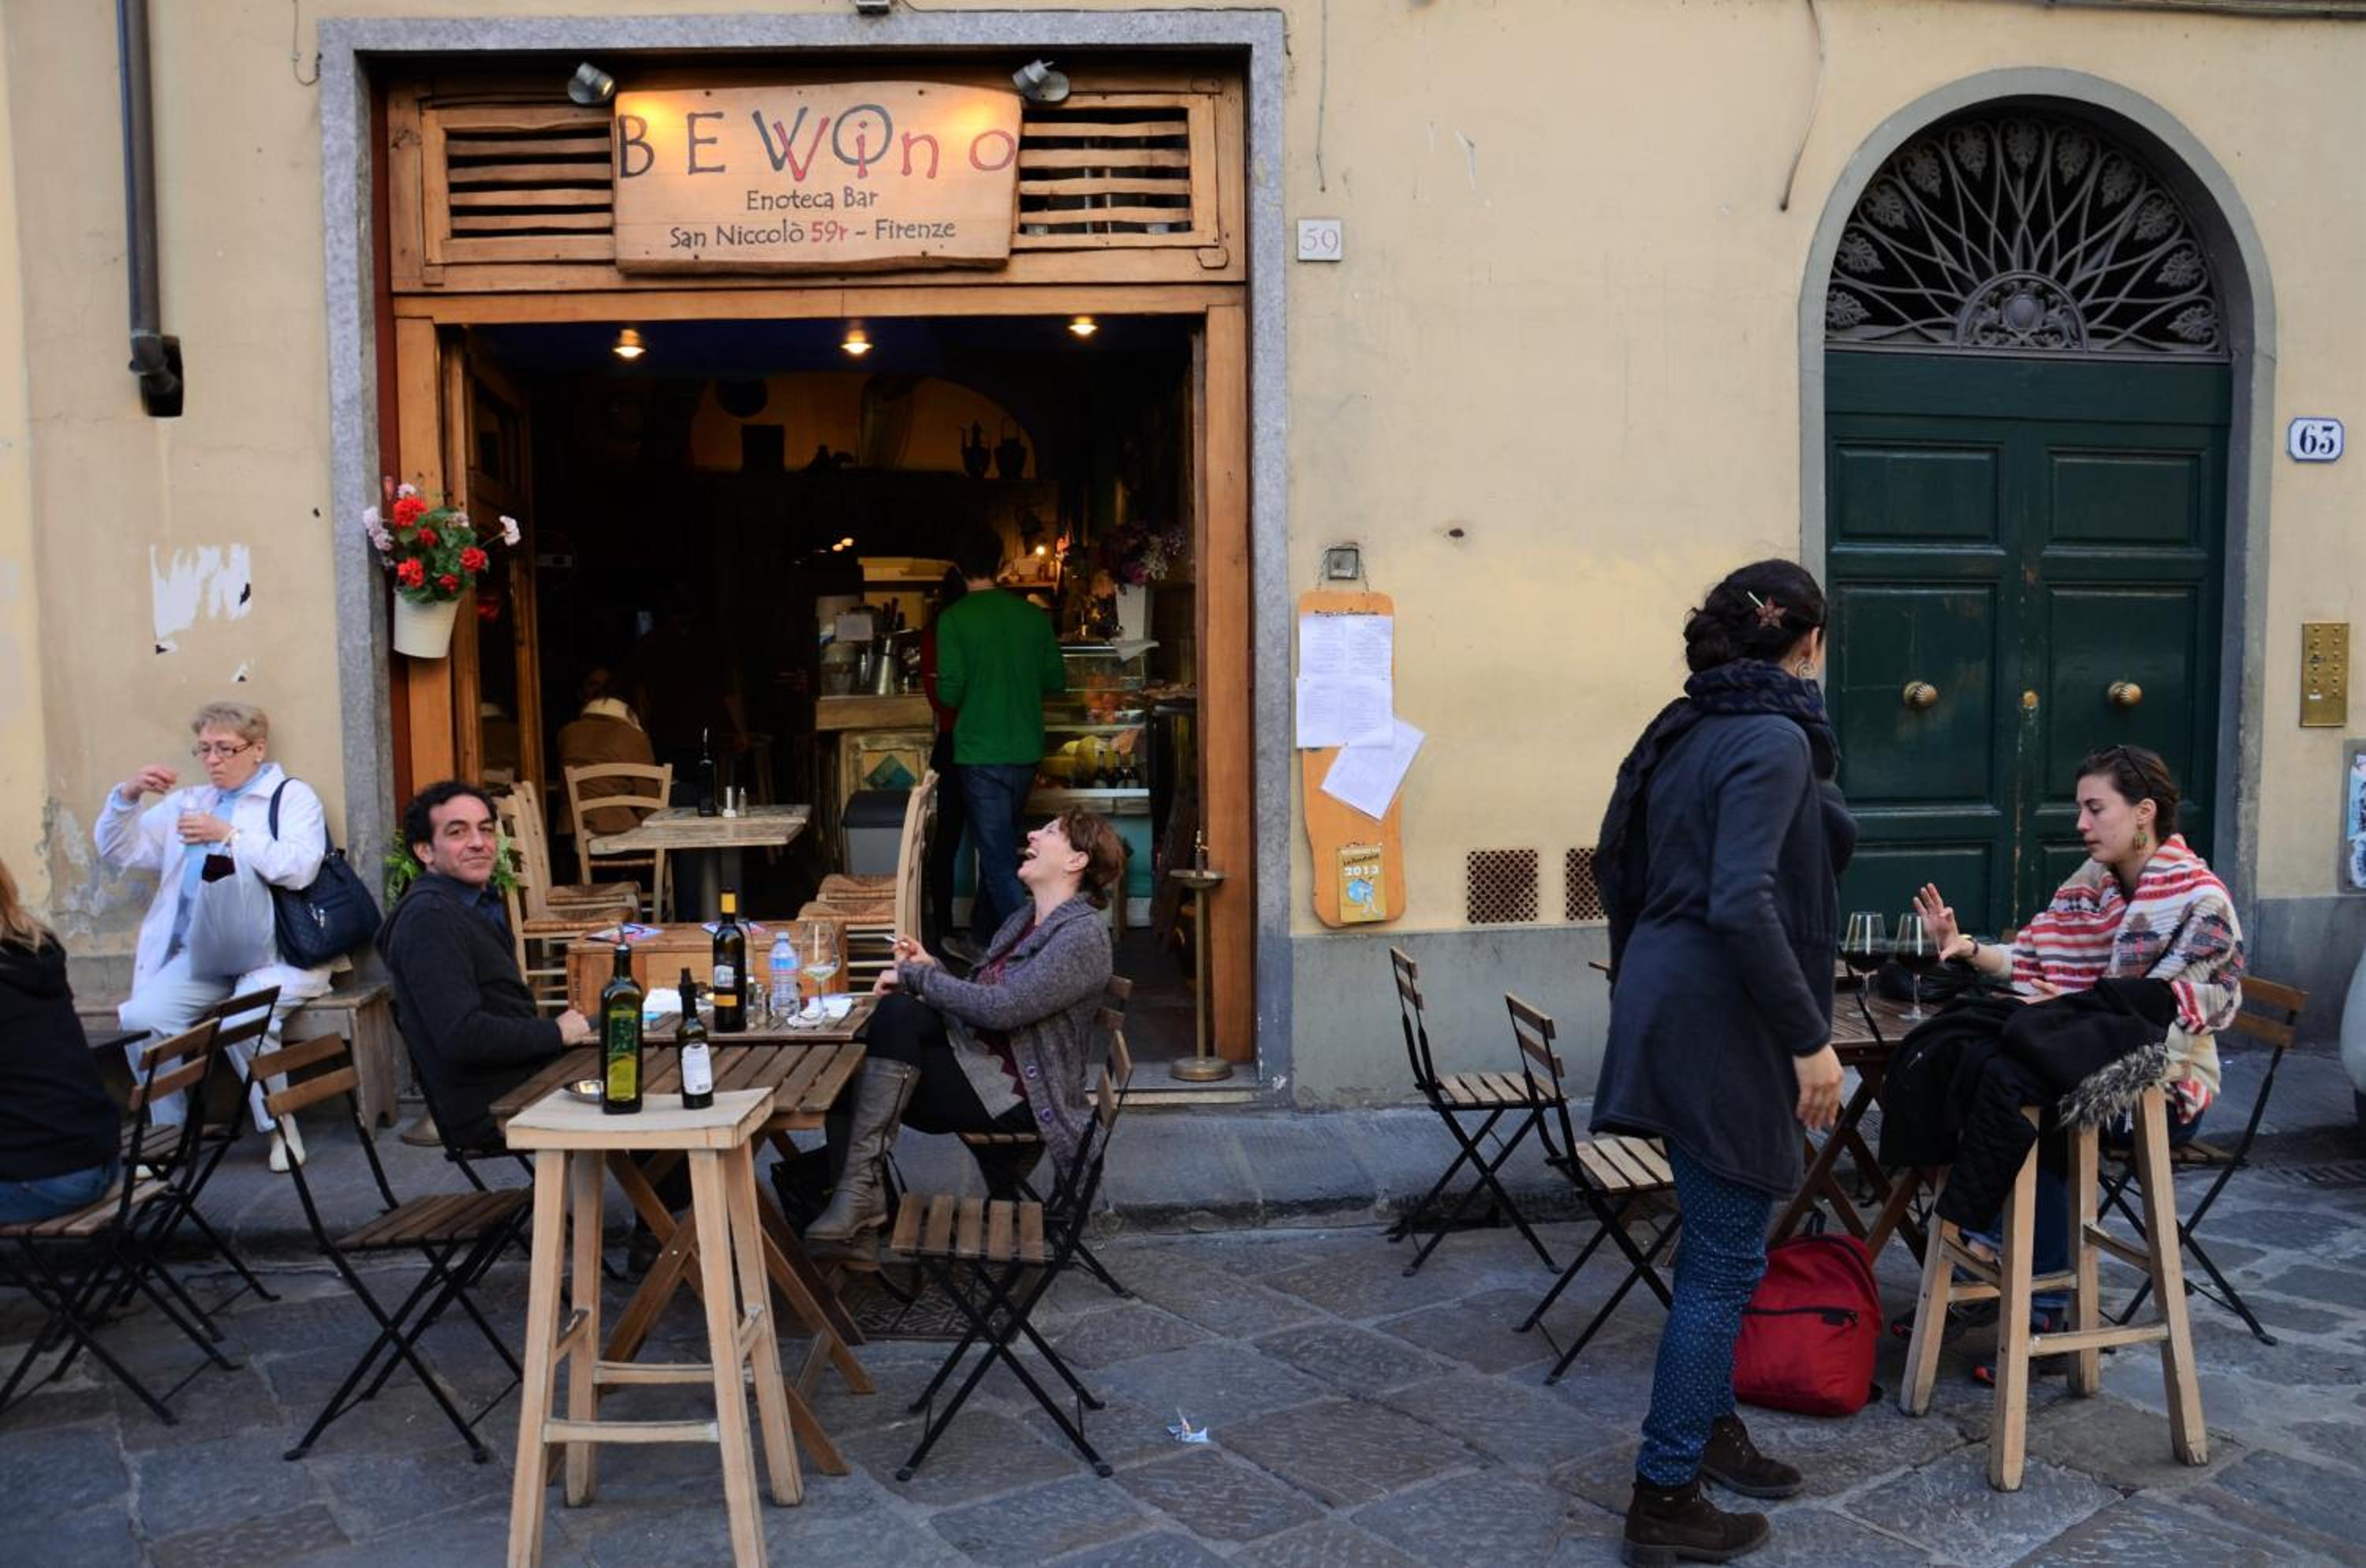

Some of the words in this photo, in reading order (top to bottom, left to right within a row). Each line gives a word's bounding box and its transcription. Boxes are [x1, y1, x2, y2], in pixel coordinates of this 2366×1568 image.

[746, 189, 834, 211] Enoteca
[843, 185, 879, 209] Bar
[670, 226, 707, 249] San
[716, 218, 804, 246] Niccolò
[811, 220, 849, 243] 59r
[875, 218, 957, 241] Firenze
